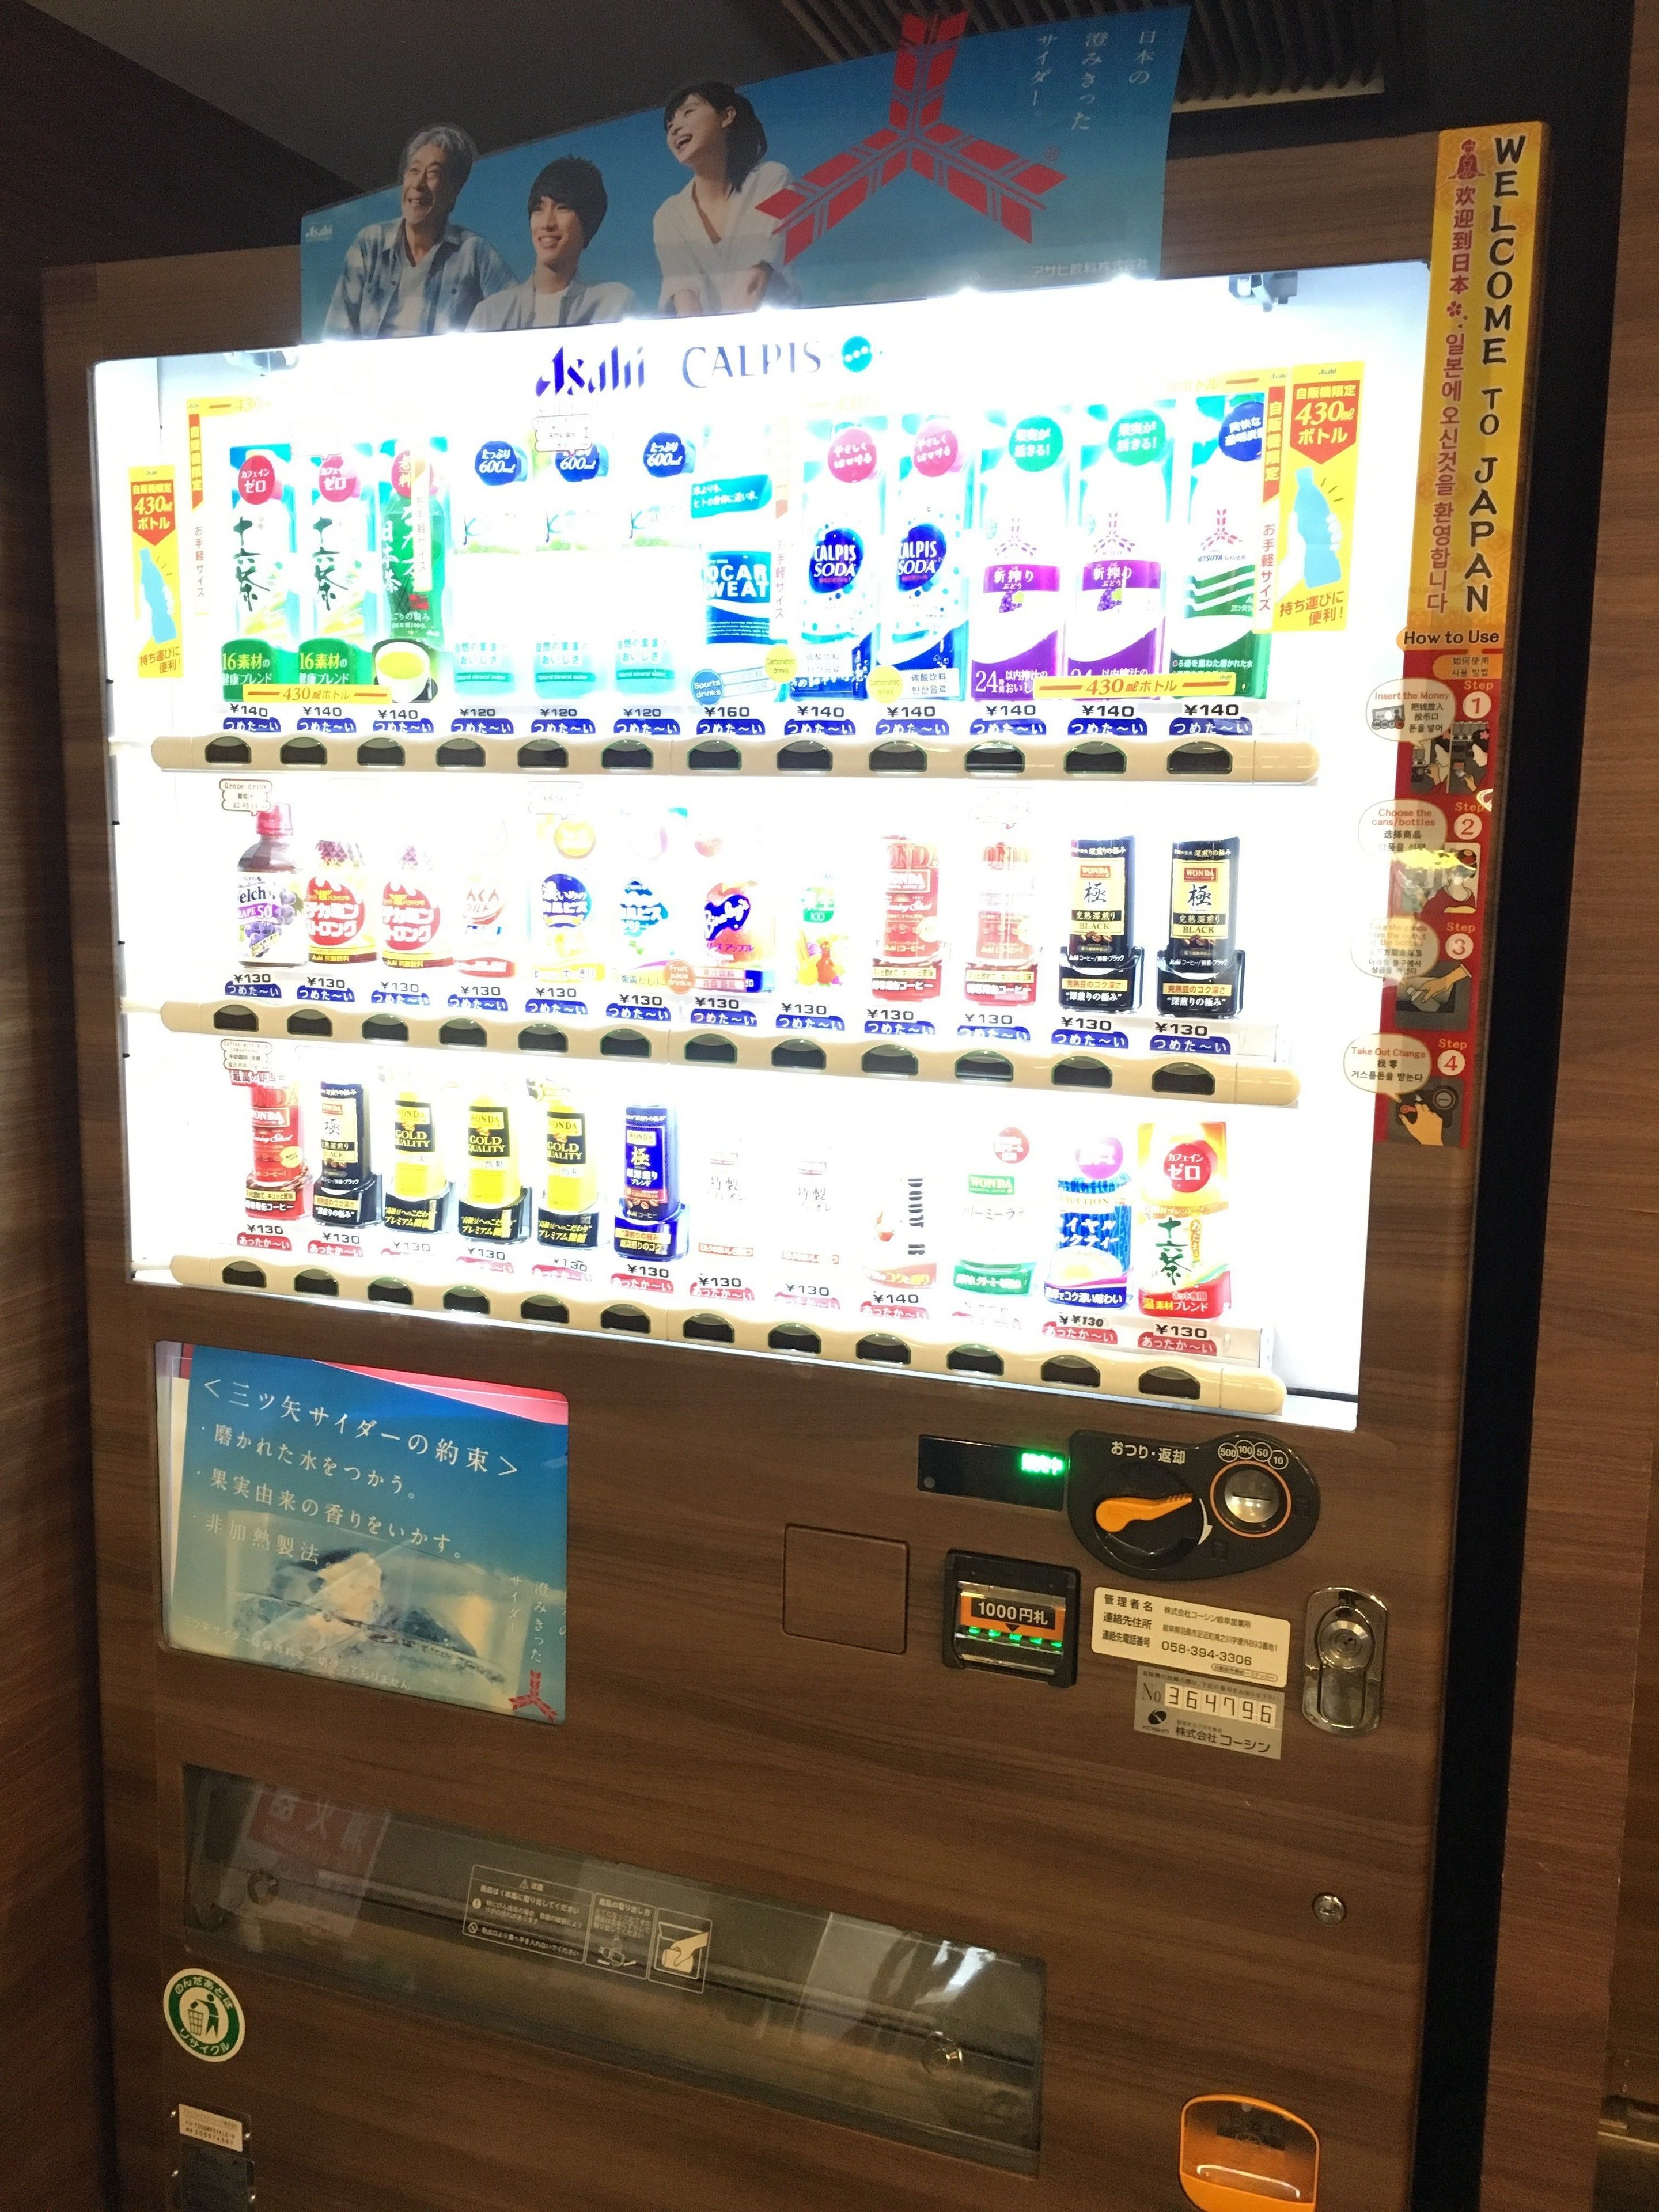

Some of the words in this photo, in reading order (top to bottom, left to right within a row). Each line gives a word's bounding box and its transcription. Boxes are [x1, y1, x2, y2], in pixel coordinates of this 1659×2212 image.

[1128, 31, 1156, 84] 日本の
[1071, 32, 1108, 130] 澄みきった
[1449, 185, 1476, 296] 欢迎到日本
[1483, 135, 1526, 364] WELCOME
[535, 344, 645, 397] Asahi
[681, 342, 823, 389] CALPIS
[1441, 333, 1465, 402] 일본에
[1296, 384, 1356, 399] 自販機限定
[1479, 388, 1503, 436] TO
[1264, 400, 1282, 482] 自販機限定
[1298, 427, 1348, 446] ボトル
[650, 441, 678, 453] たっぷり
[1435, 406, 1460, 497] 오신것을
[481, 449, 510, 460] たっぷり
[646, 452, 681, 468] 600ml
[479, 460, 516, 475] 600ml
[559, 457, 596, 471] 600ml
[241, 468, 270, 478] カフェイン
[132, 483, 172, 494] 自販機限定
[244, 479, 266, 494] ゼロ
[323, 476, 346, 491] ゼロ
[138, 517, 170, 530] ボトル
[1465, 457, 1498, 613] JAPAN
[814, 543, 856, 562] CALPIS
[1427, 502, 1455, 615] 환영합니다
[814, 562, 855, 577] SODA
[898, 559, 935, 575] SODA
[1279, 592, 1345, 618] 持ち運びに
[1404, 631, 1440, 645] How
[1446, 632, 1463, 643] to
[1469, 630, 1499, 643] Use
[139, 647, 180, 666] 持ち運びに
[222, 653, 270, 670] 16素材の
[300, 653, 348, 670] 16素材の
[1453, 657, 1489, 665] 如何使用
[911, 673, 946, 681] 碳酸饮料
[1452, 669, 1467, 677] 사용
[1472, 668, 1488, 677] 방법
[693, 680, 721, 690] Sports
[912, 685, 946, 694] 탄산음료
[1464, 681, 1493, 691] Step
[696, 689, 722, 698] drinks
[1420, 692, 1449, 700] Money
[230, 704, 268, 717] ¥140
[303, 706, 342, 717] ¥140
[460, 708, 495, 717] ¥120
[540, 708, 577, 717] ¥120
[623, 708, 661, 717] ¥120
[704, 707, 750, 717] ¥160
[797, 706, 844, 718] ¥140
[887, 706, 935, 718] ¥140
[986, 705, 1036, 717] ¥140
[1081, 704, 1135, 718] ¥140
[1411, 703, 1444, 711] 把钱放入
[1472, 697, 1481, 714] 1
[377, 710, 418, 719] ¥140
[1455, 802, 1483, 813] Step
[1461, 819, 1474, 835] 2
[1384, 830, 1422, 839] 选择商品
[1185, 869, 1215, 878] WONDA
[1084, 882, 1107, 903] 極
[1187, 884, 1212, 906] 極
[257, 904, 272, 919] 50
[1080, 922, 1109, 930] BLACK
[1179, 915, 1219, 924] 完熟深煎り
[1183, 925, 1215, 933] BLACK
[1447, 922, 1475, 933] Step
[1452, 939, 1465, 955] 3
[233, 974, 271, 983] ¥130
[306, 977, 345, 988] ¥130
[381, 981, 419, 993] ¥130
[461, 986, 501, 996] ¥130
[536, 987, 577, 997] ¥130
[619, 994, 662, 1006] ¥130
[695, 997, 740, 1009] ¥130
[781, 1003, 827, 1014] ¥130
[867, 1009, 914, 1020] ¥130
[1061, 1016, 1112, 1031] ¥130
[1154, 1022, 1207, 1036] ¥130
[1438, 1039, 1467, 1050] Step
[1393, 1050, 1426, 1058] Change
[1444, 1056, 1458, 1070] 4
[1351, 1071, 1394, 1081] 거스름돈을
[1397, 1073, 1423, 1082] 받는다
[395, 1130, 427, 1139] GOLD
[469, 1136, 502, 1145] GOLD
[547, 1142, 579, 1152] GOLD
[631, 1146, 650, 1166] 極
[1168, 1153, 1203, 1164] カフェイン
[1168, 1165, 1200, 1180] ゼロ
[969, 1177, 1012, 1188] WONDA
[247, 1224, 283, 1234] ¥130
[323, 1232, 359, 1244] ¥130
[1155, 1218, 1192, 1286] 十六茶
[627, 1264, 669, 1278] ¥130
[1142, 1338, 1213, 1353] あったか～い
[1111, 1441, 1186, 1464] おつり・返却
[1221, 1448, 1237, 1458] 500
[1238, 1445, 1253, 1455] 100
[1257, 1448, 1268, 1458] 50
[1272, 1455, 1283, 1464] 10
[509, 1576, 521, 1635] サイダー
[1104, 1594, 1153, 1612] 管理者名
[978, 1601, 1048, 1625] 1000円札
[531, 1581, 549, 1662] 澄みきった
[1103, 1612, 1152, 1630] 連絡先住所
[1102, 1630, 1150, 1647] 連絡先電話番号
[1162, 1641, 1252, 1665] 058-394-3306
[1142, 1682, 1161, 1703] No
[1169, 1687, 1272, 1724] 364796
[180, 2028, 229, 2055] リサイクル
